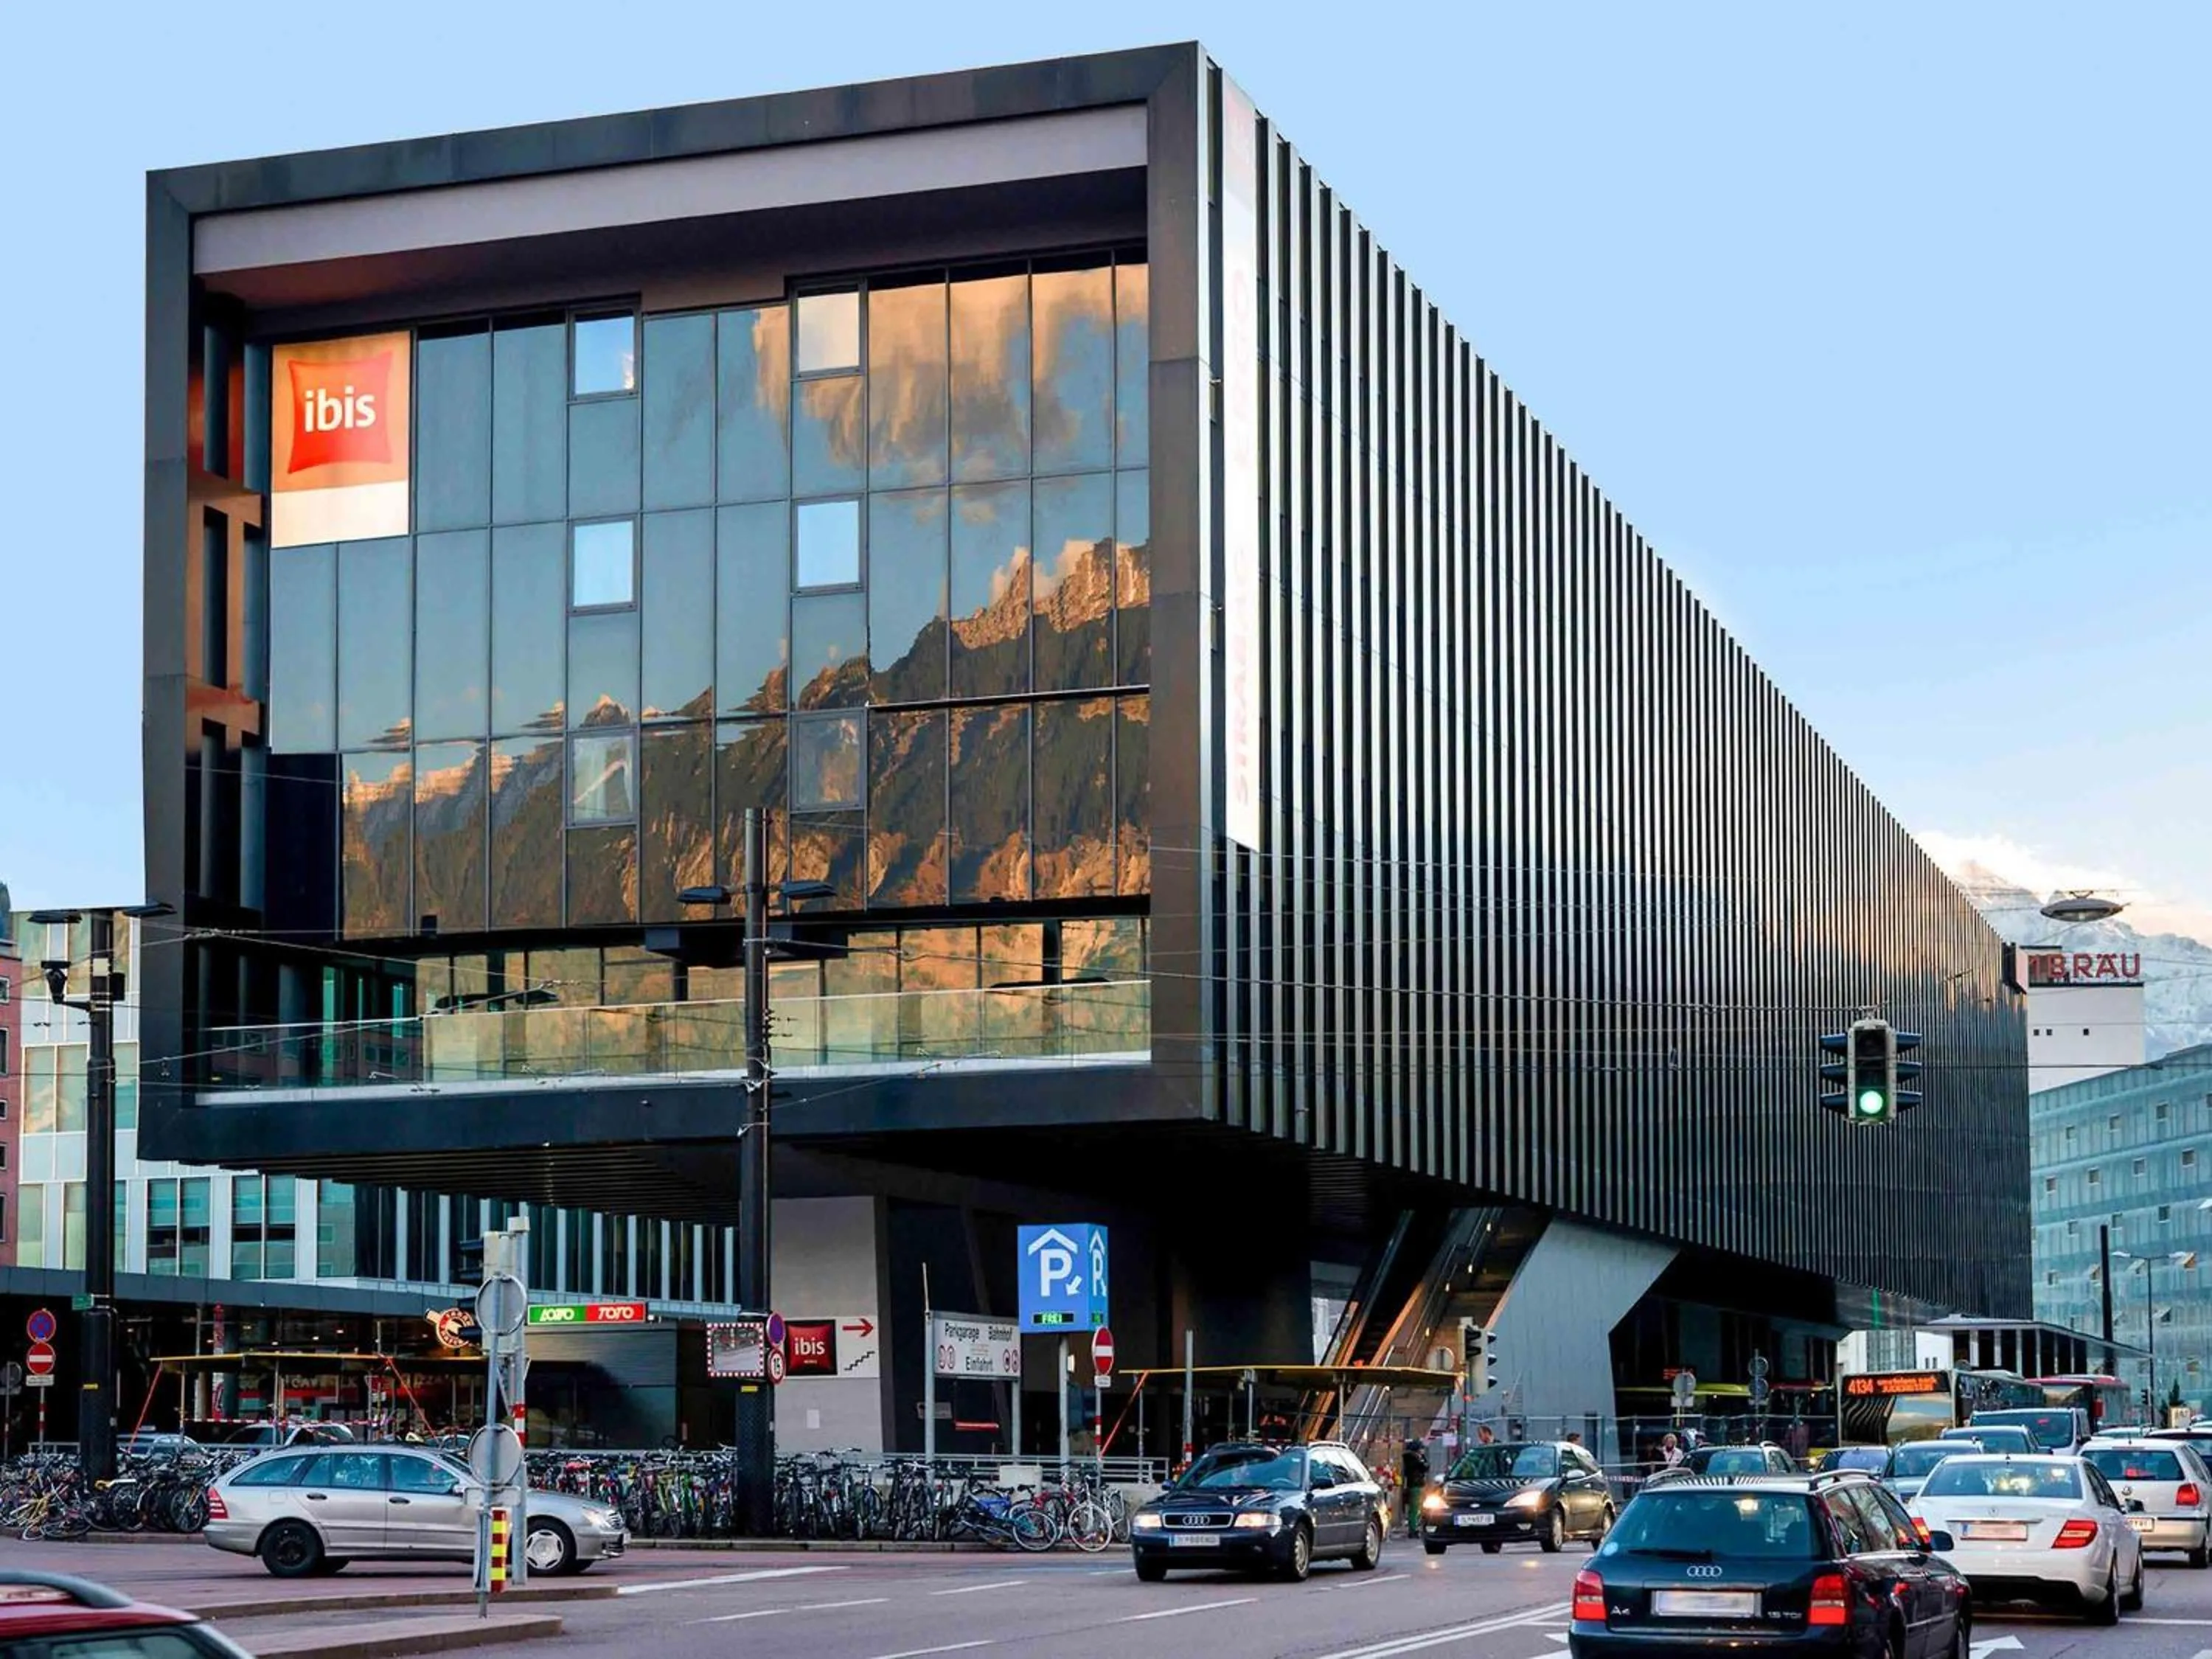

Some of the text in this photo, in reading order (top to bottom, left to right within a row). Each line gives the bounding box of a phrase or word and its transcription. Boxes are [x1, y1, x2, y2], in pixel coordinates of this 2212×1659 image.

[305, 385, 376, 432] ibis
[1040, 1248, 1072, 1297] P
[598, 1307, 635, 1320] TOTO
[794, 1336, 825, 1355] ibis
[1848, 1378, 1874, 1395] 4134
